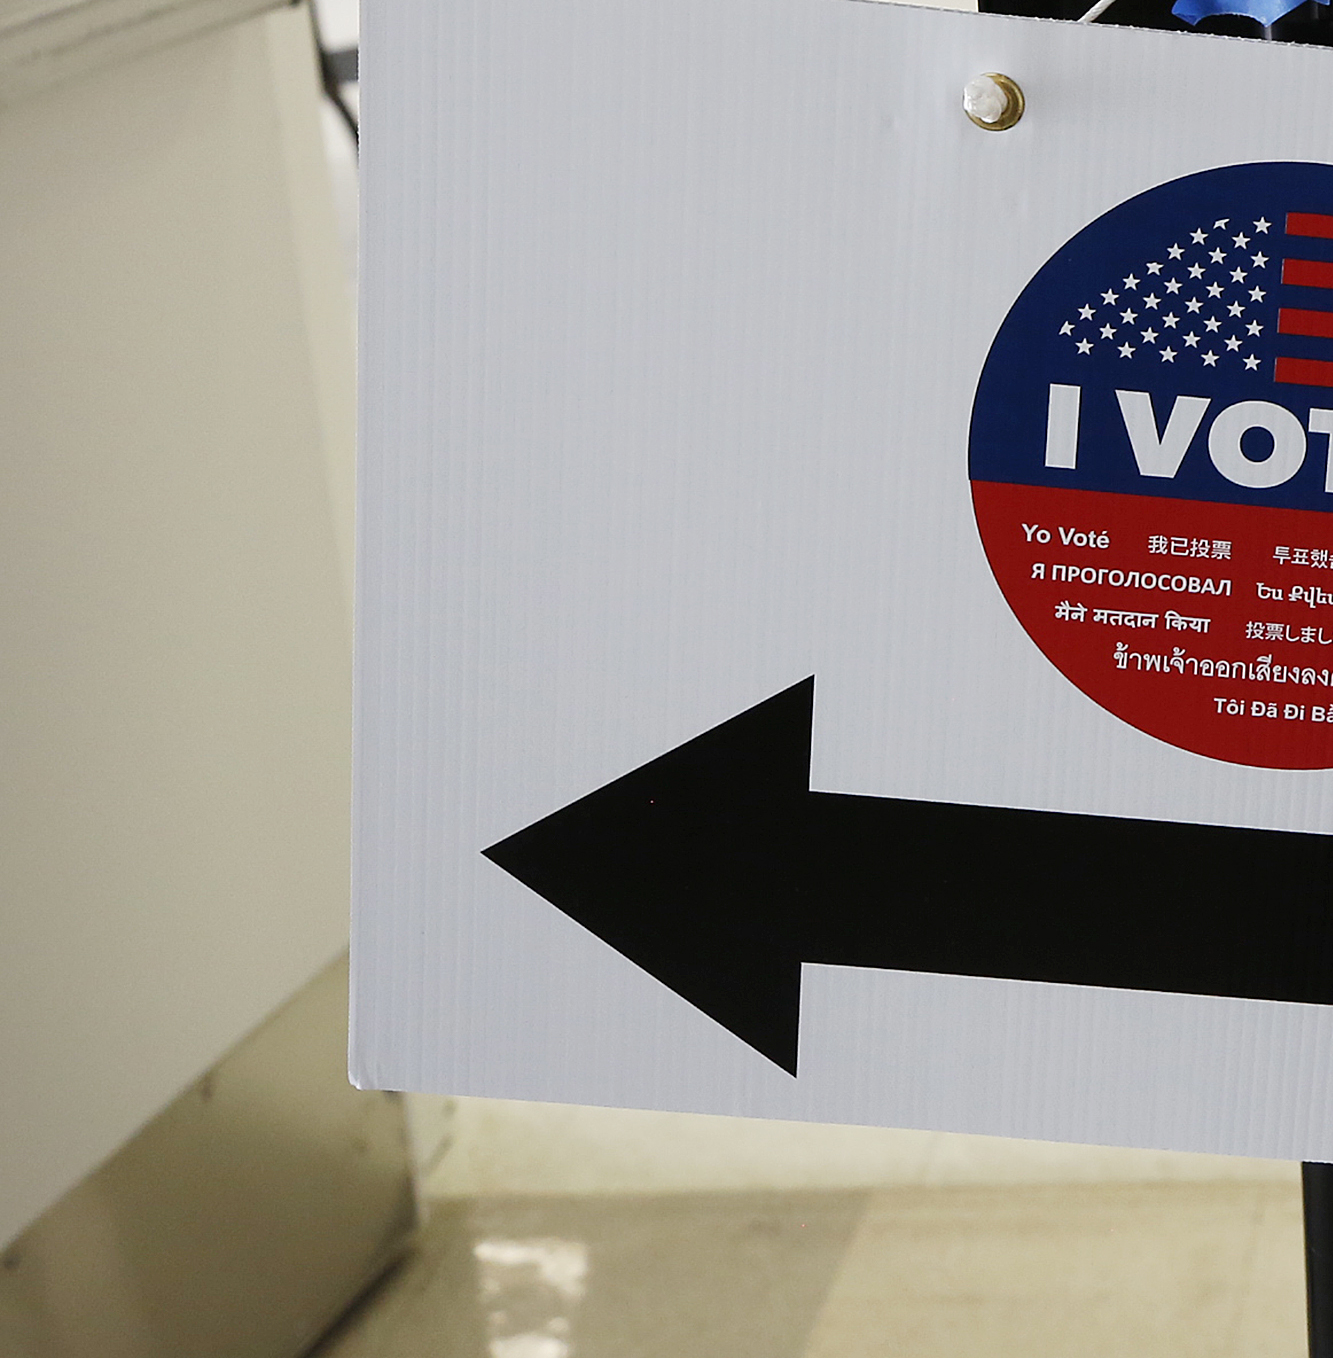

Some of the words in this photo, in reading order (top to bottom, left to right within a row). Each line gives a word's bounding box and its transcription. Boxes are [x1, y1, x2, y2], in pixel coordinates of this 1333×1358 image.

[1044, 383, 1082, 470] I
[1021, 523, 1051, 544] Yo
[1058, 526, 1110, 549] Voté
[1147, 534, 1232, 560] 我已投票
[1030, 562, 1046, 580] Я
[1051, 564, 1232, 597] ПРОГОЛОСОВАЛ
[1255, 582, 1284, 601] Ես
[1092, 608, 1160, 629] मतदान
[1164, 609, 1212, 634] किया
[1213, 697, 1246, 716] Tôi
[1250, 700, 1278, 719] Đã
[1283, 703, 1306, 721] Đi
